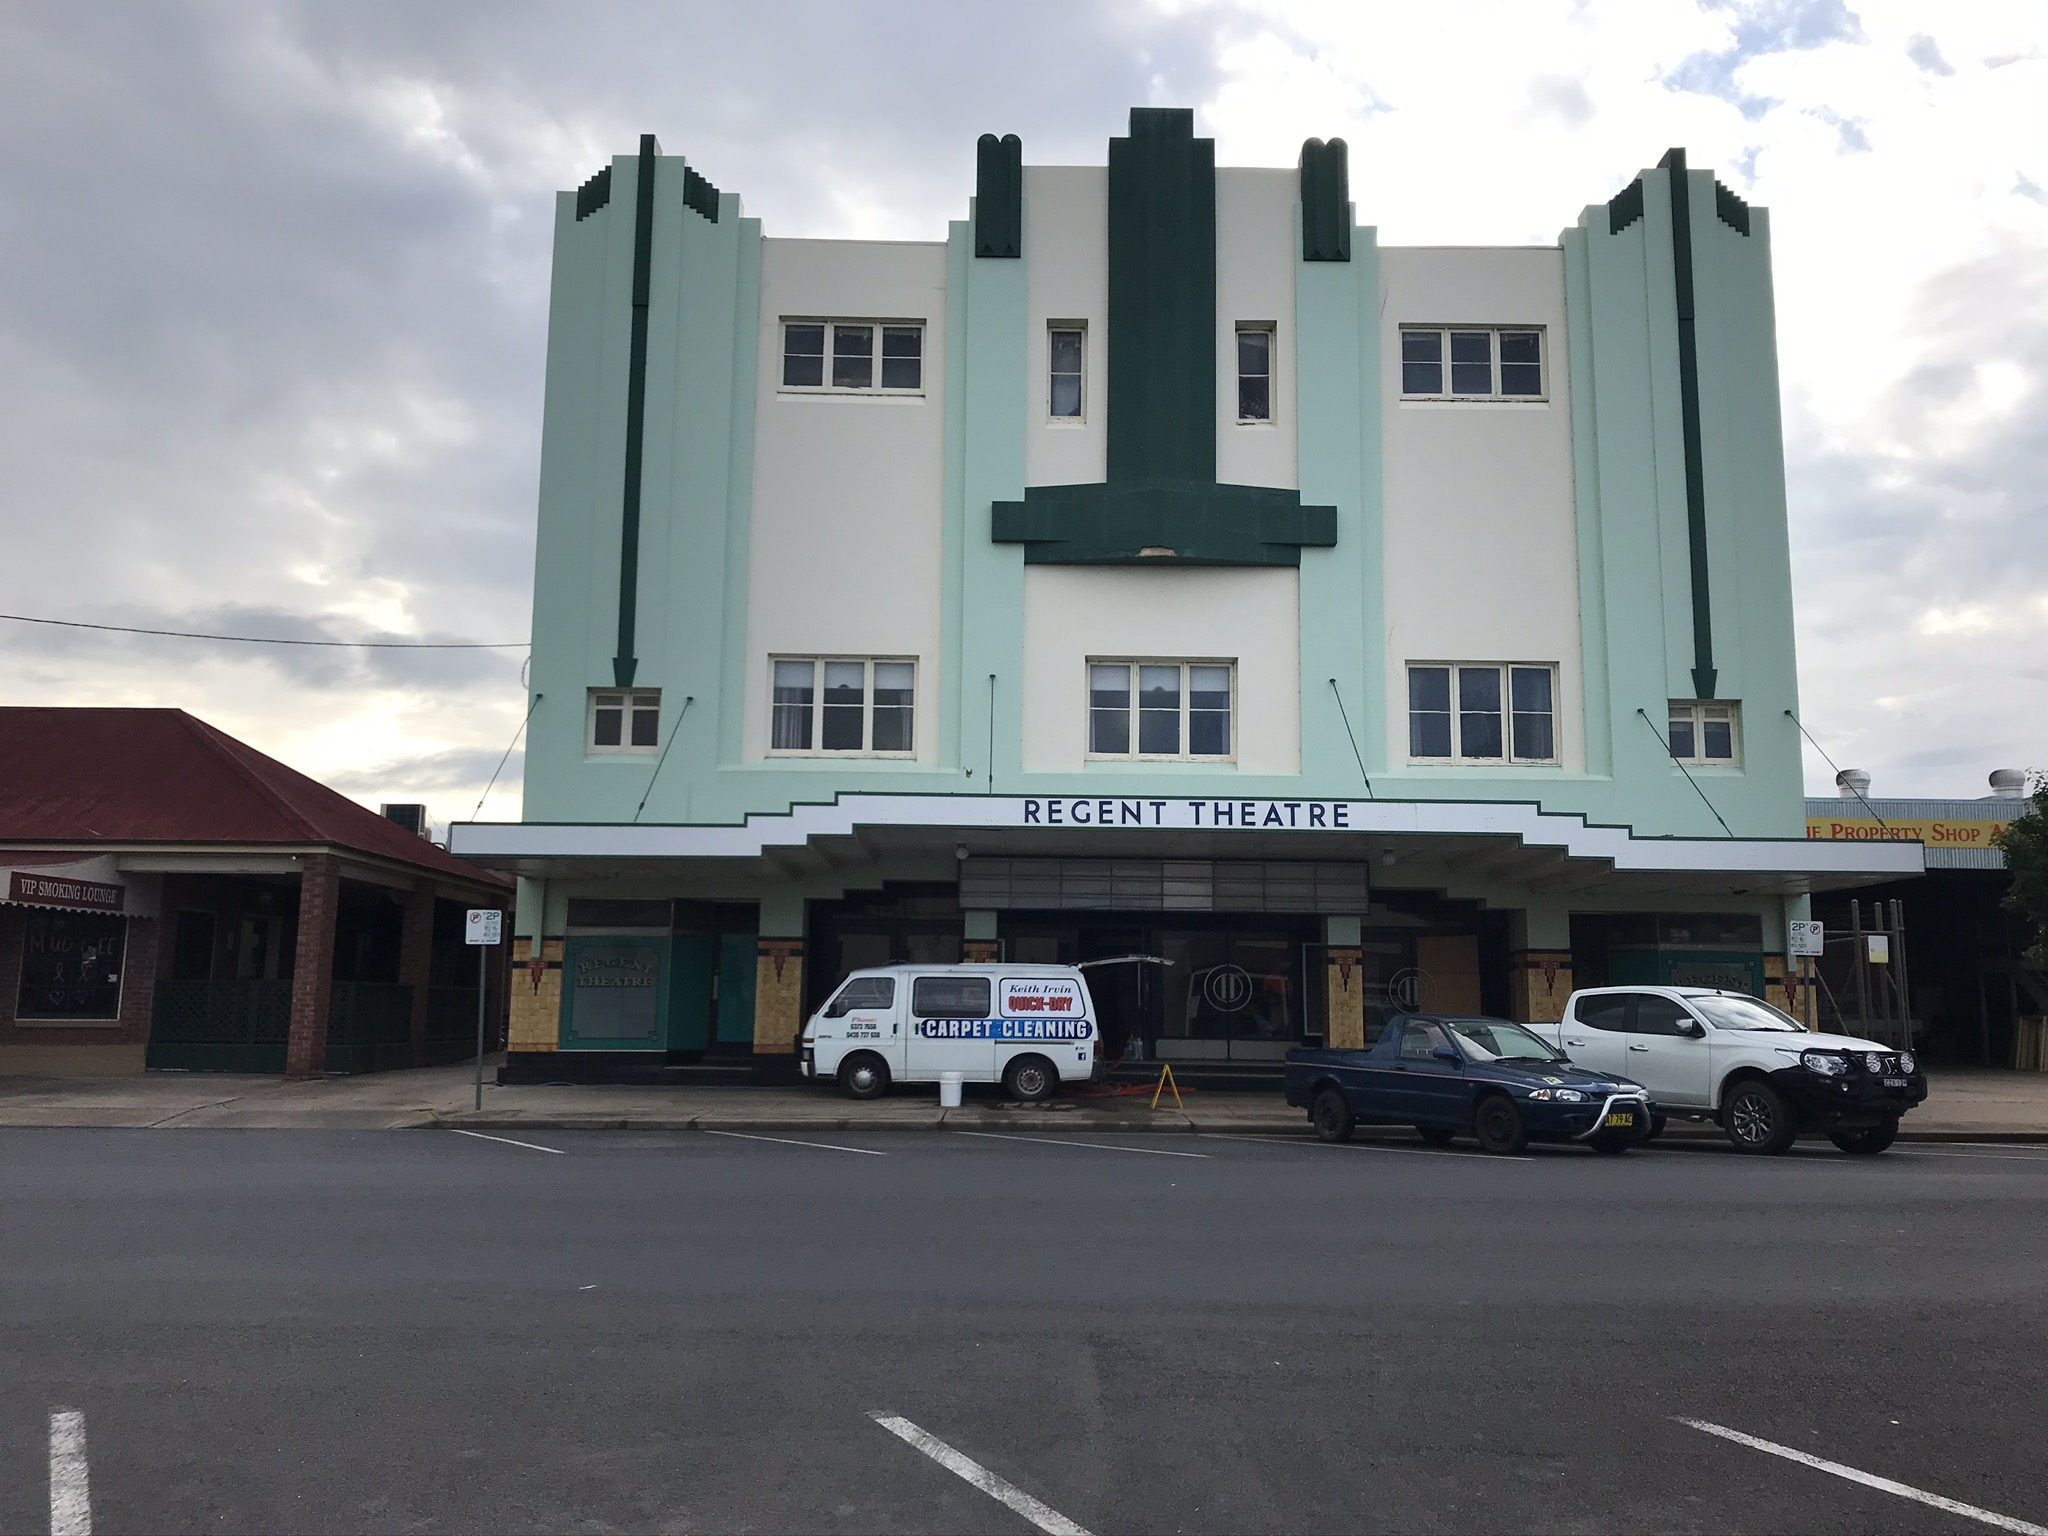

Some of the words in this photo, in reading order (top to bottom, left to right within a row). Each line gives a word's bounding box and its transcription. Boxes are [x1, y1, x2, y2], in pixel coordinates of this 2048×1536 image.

[1024, 799, 1166, 825] REGENT
[1189, 801, 1349, 828] THEATRE
[21, 879, 37, 895] VIP
[39, 881, 80, 900] SMOKING
[82, 886, 117, 903] LOUNGE
[486, 911, 500, 921] 2P
[1791, 922, 1806, 931] 2P
[578, 957, 653, 974] REGENT
[577, 976, 652, 988] THEATRE
[1009, 984, 1039, 993] Keith
[1043, 984, 1072, 994] Irvin
[1008, 995, 1073, 1012] QUICK-DRY
[926, 1019, 993, 1037] CARPET
[1002, 1020, 1087, 1038] CLEANING
